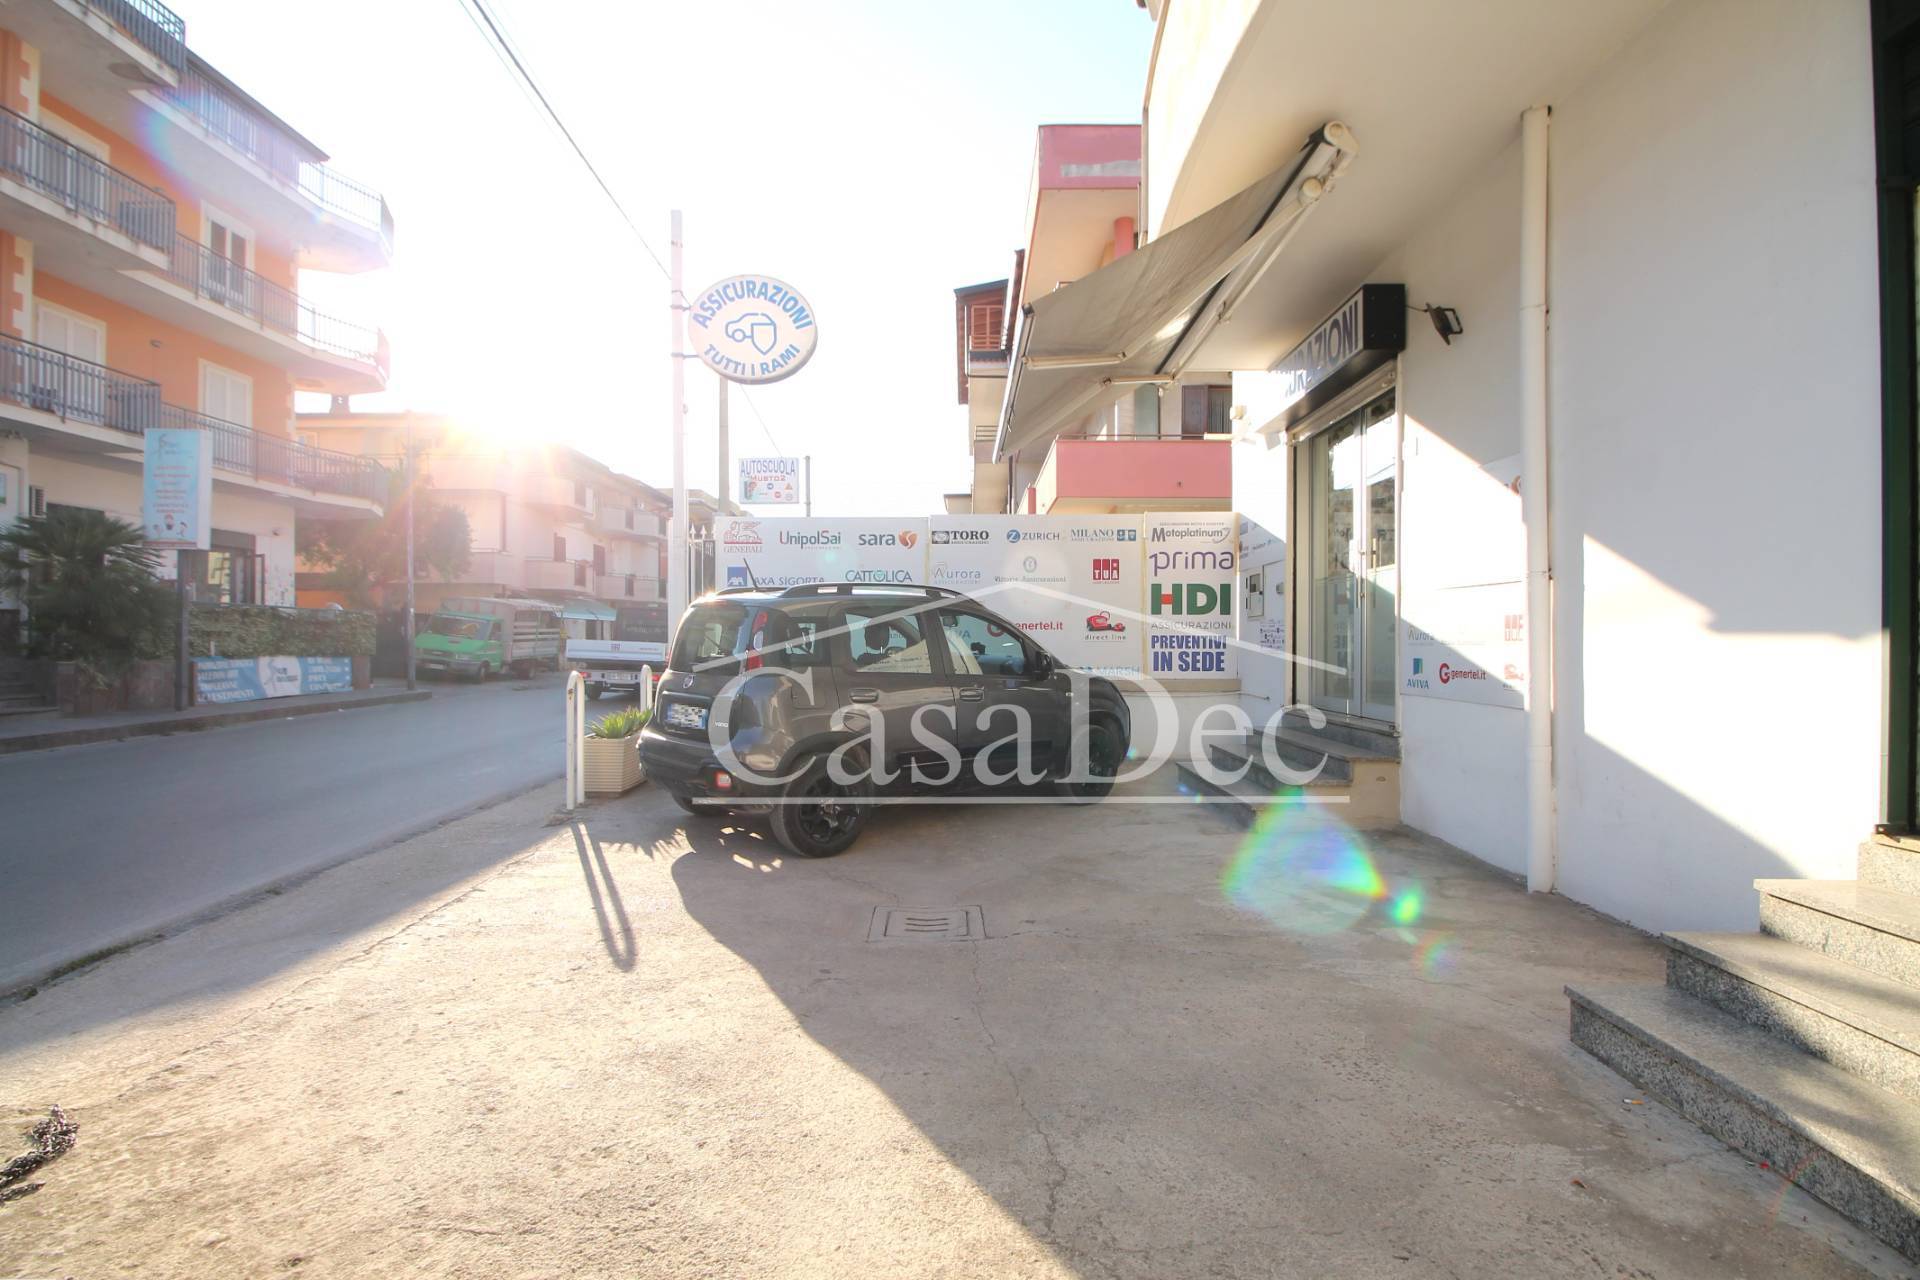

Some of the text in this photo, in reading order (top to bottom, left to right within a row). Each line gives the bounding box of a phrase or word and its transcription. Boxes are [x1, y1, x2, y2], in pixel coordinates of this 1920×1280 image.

[692, 279, 813, 329] ASSICURAZIONI
[704, 343, 801, 376] TUTTI I RAMI
[740, 459, 796, 476] AUTOSCUOLA
[780, 531, 841, 549] UnipolSai
[858, 533, 896, 546] sara
[951, 530, 990, 540] TORO
[1022, 532, 1060, 541] ZURICH
[1071, 529, 1114, 538] MILANO
[1152, 527, 1223, 542] Motoplatinum
[1149, 551, 1234, 577] prima
[845, 570, 913, 583] CATTOLICA
[934, 567, 981, 580] Aurora
[1094, 569, 1118, 580] TUA
[1151, 583, 1231, 616] HDI
[1151, 621, 1231, 630] ASSICURAZIONI
[1111, 633, 1127, 641] line
[1151, 635, 1227, 649] PREVENTIVI
[1153, 651, 1226, 672] IN SEDE
[1451, 669, 1487, 681] genertel.it
[1406, 678, 1430, 690] AVIVA
